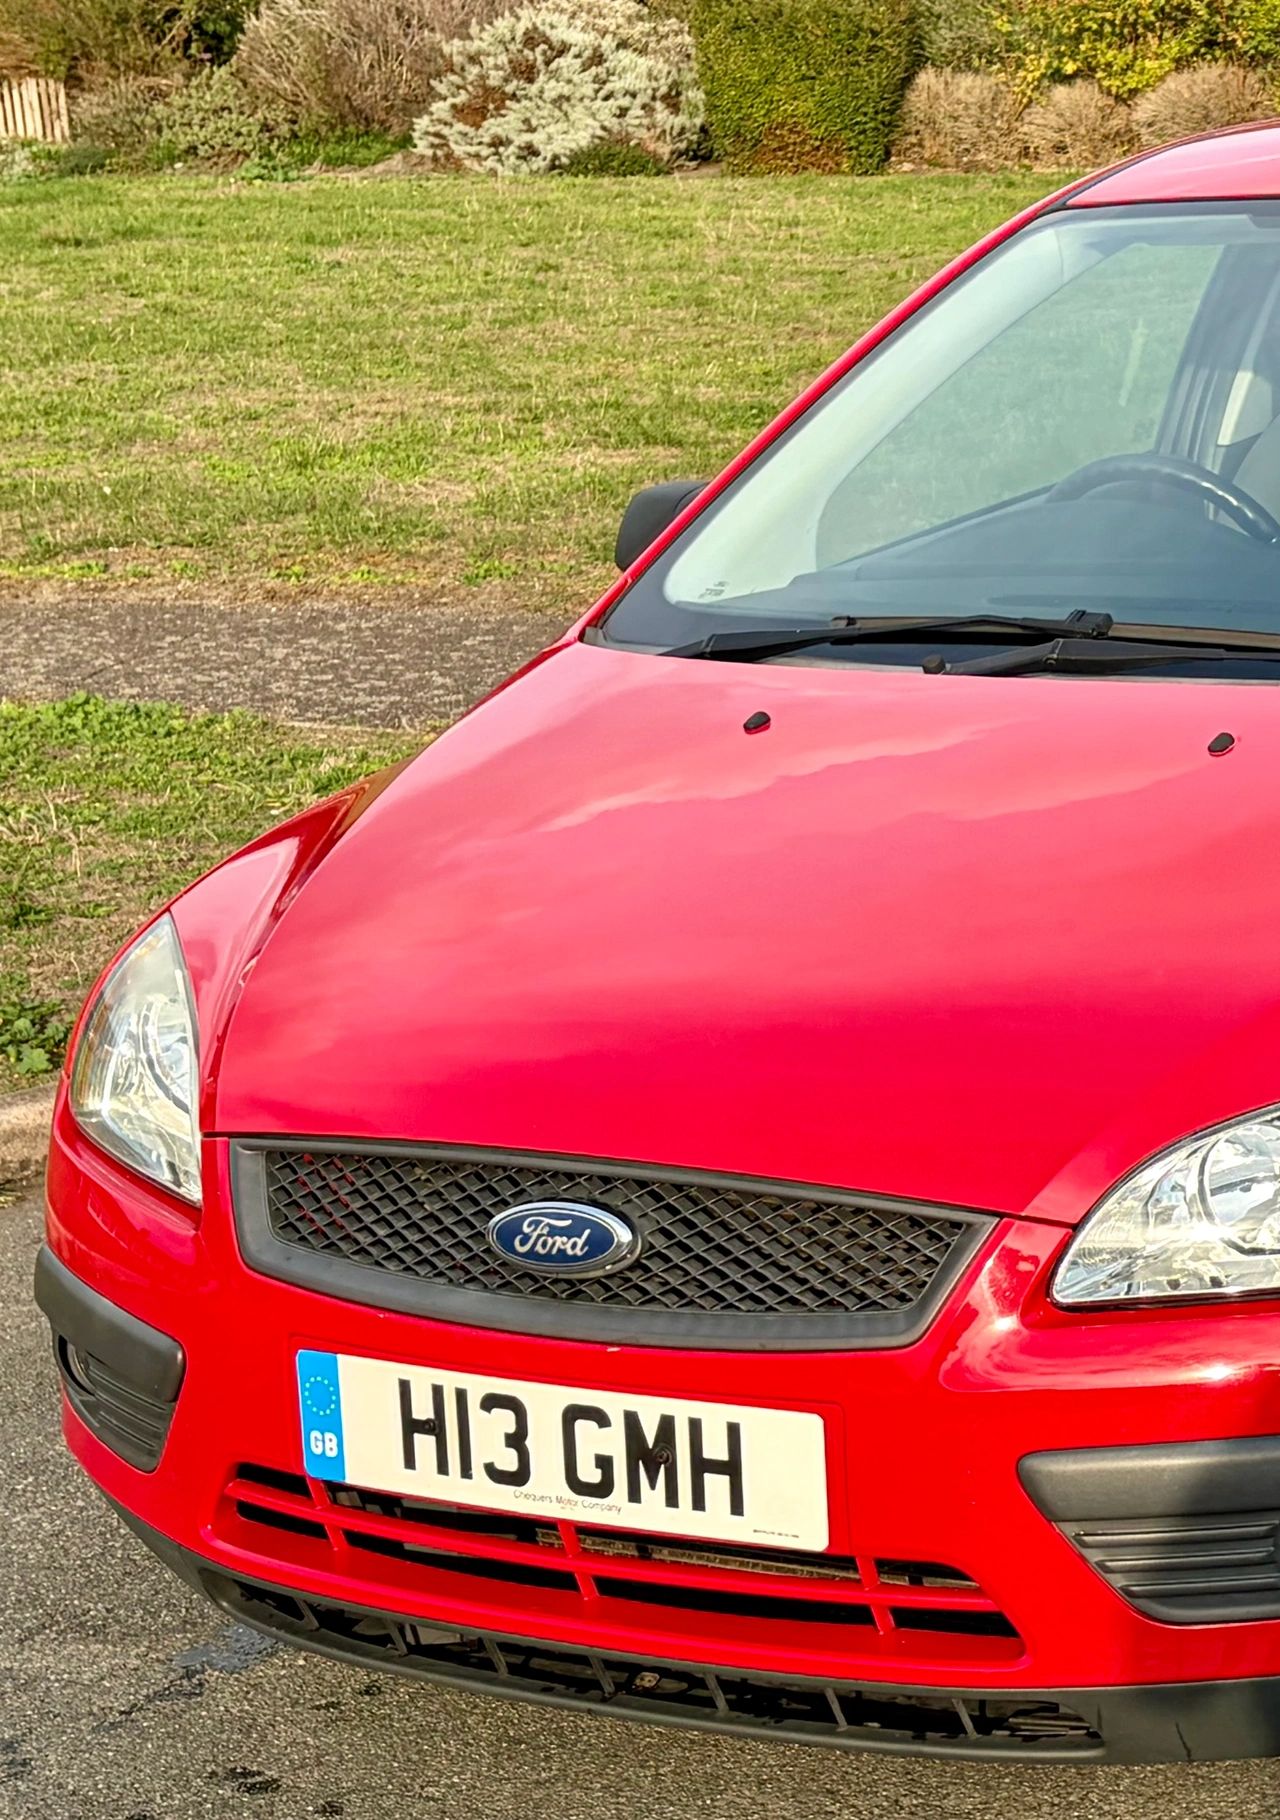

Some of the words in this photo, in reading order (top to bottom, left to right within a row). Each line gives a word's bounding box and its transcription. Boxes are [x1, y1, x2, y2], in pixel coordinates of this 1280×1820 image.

[514, 1216, 591, 1256] Ford
[310, 1429, 339, 1458] GB
[398, 1377, 531, 1488] H13
[561, 1403, 745, 1517] GMH
[581, 1499, 622, 1515] Company
